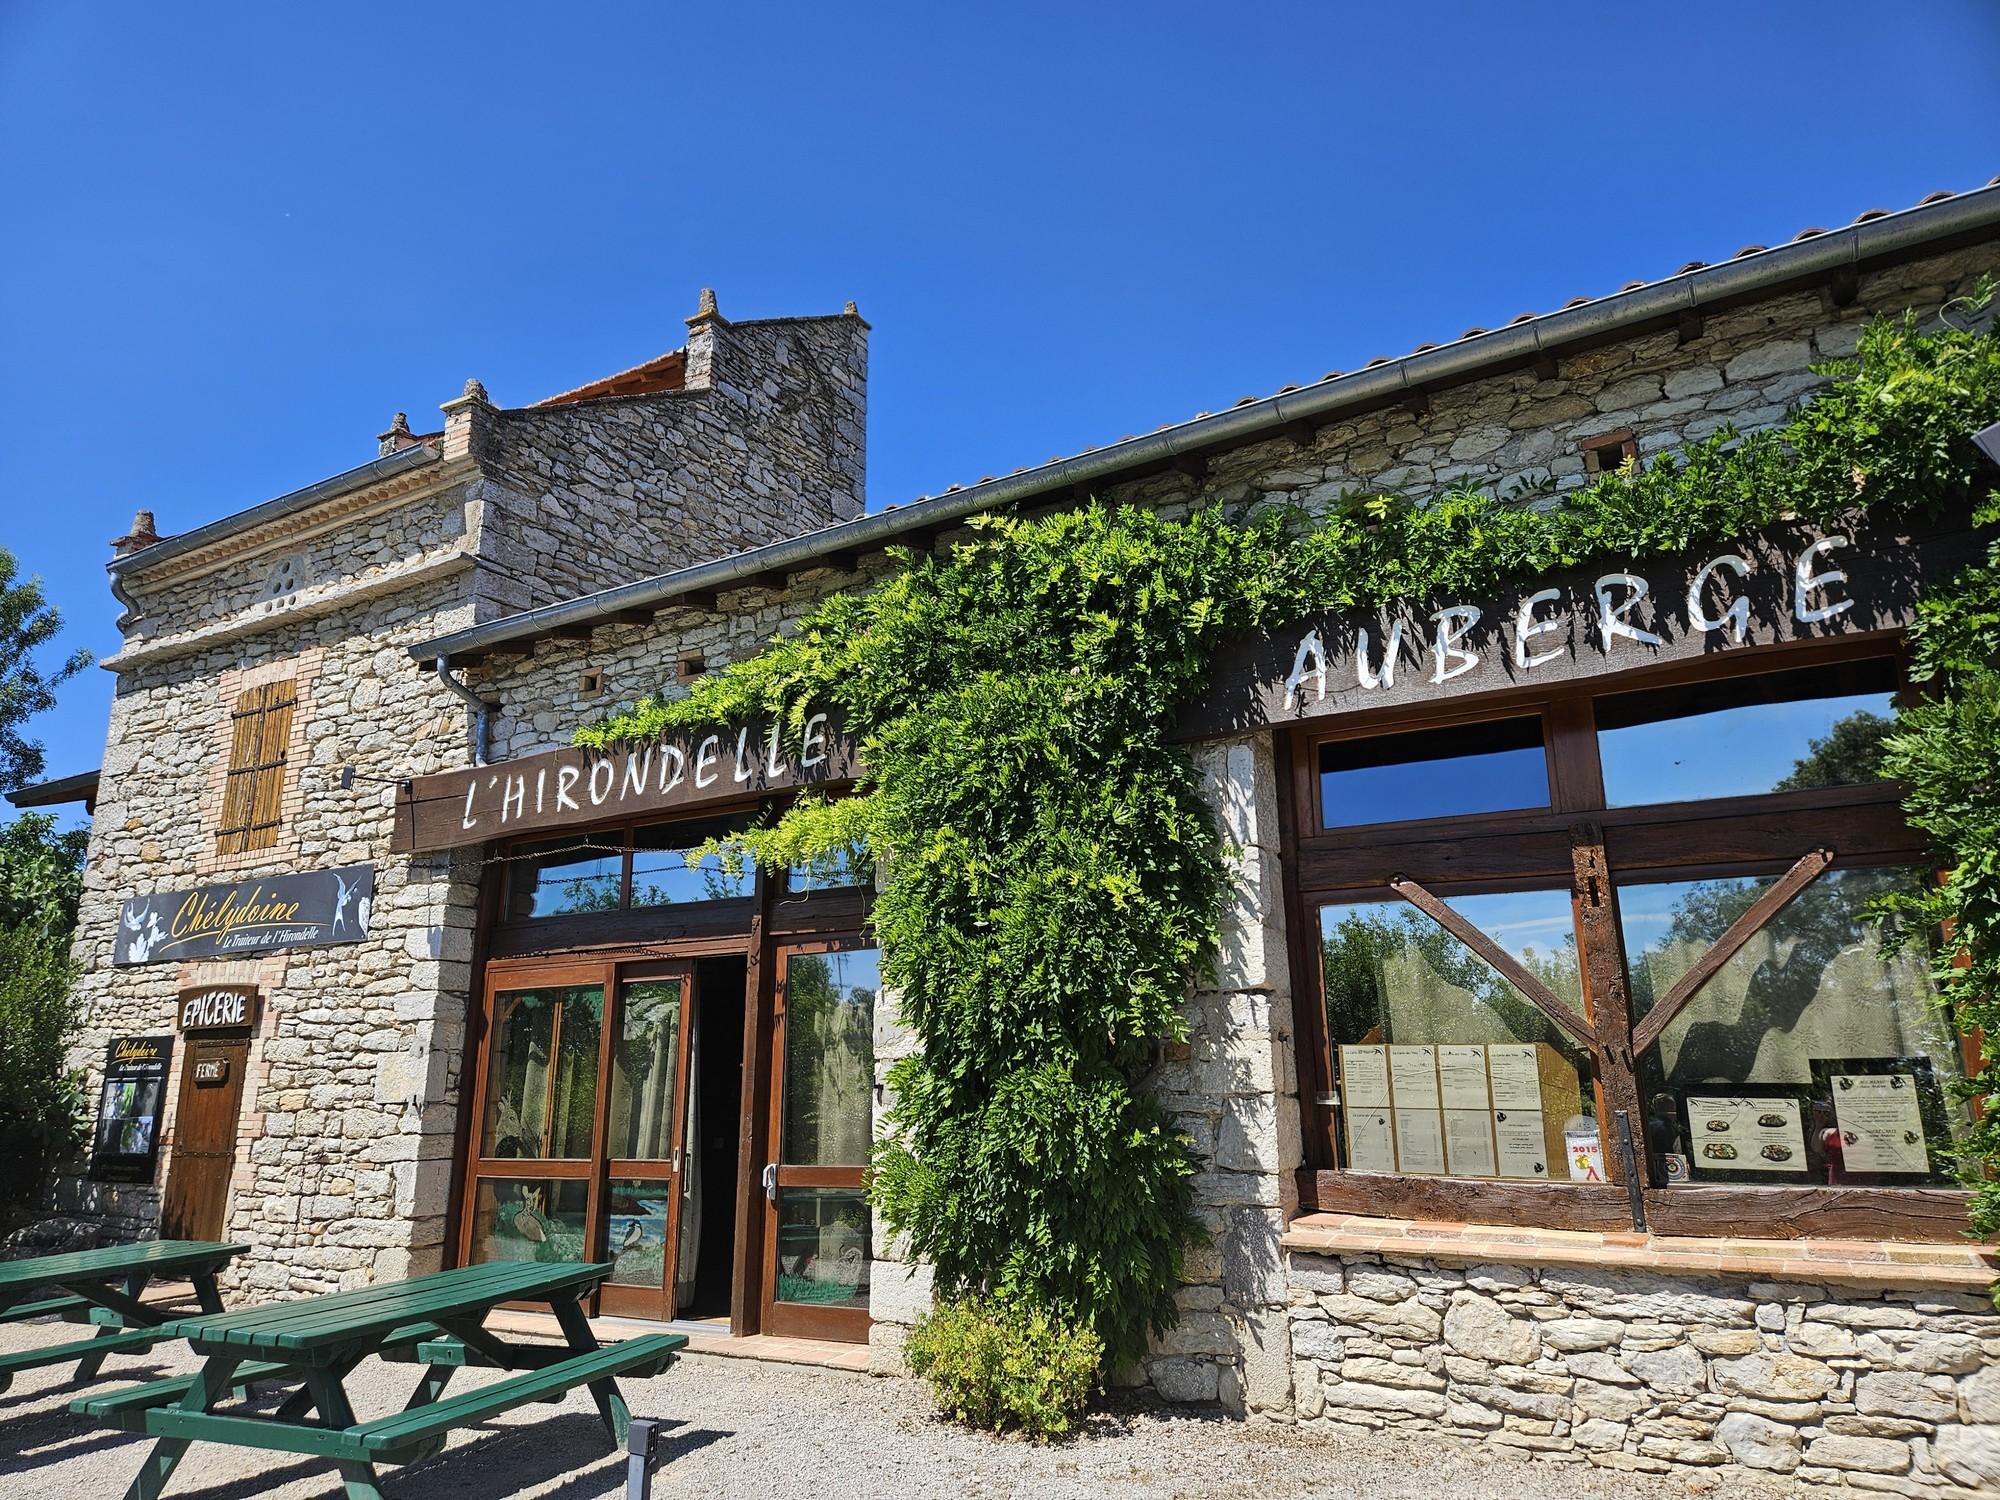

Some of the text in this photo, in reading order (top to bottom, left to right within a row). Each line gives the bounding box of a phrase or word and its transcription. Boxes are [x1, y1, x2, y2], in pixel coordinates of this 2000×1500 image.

[1284, 535, 1854, 710] AUBERGE
[463, 713, 827, 829] L'HIRONDELLE
[171, 884, 300, 944] Chélydoine
[222, 935, 232, 948] Le
[231, 933, 261, 947] Traiteur
[260, 931, 272, 944] de
[182, 991, 246, 1027] EPICERIE
